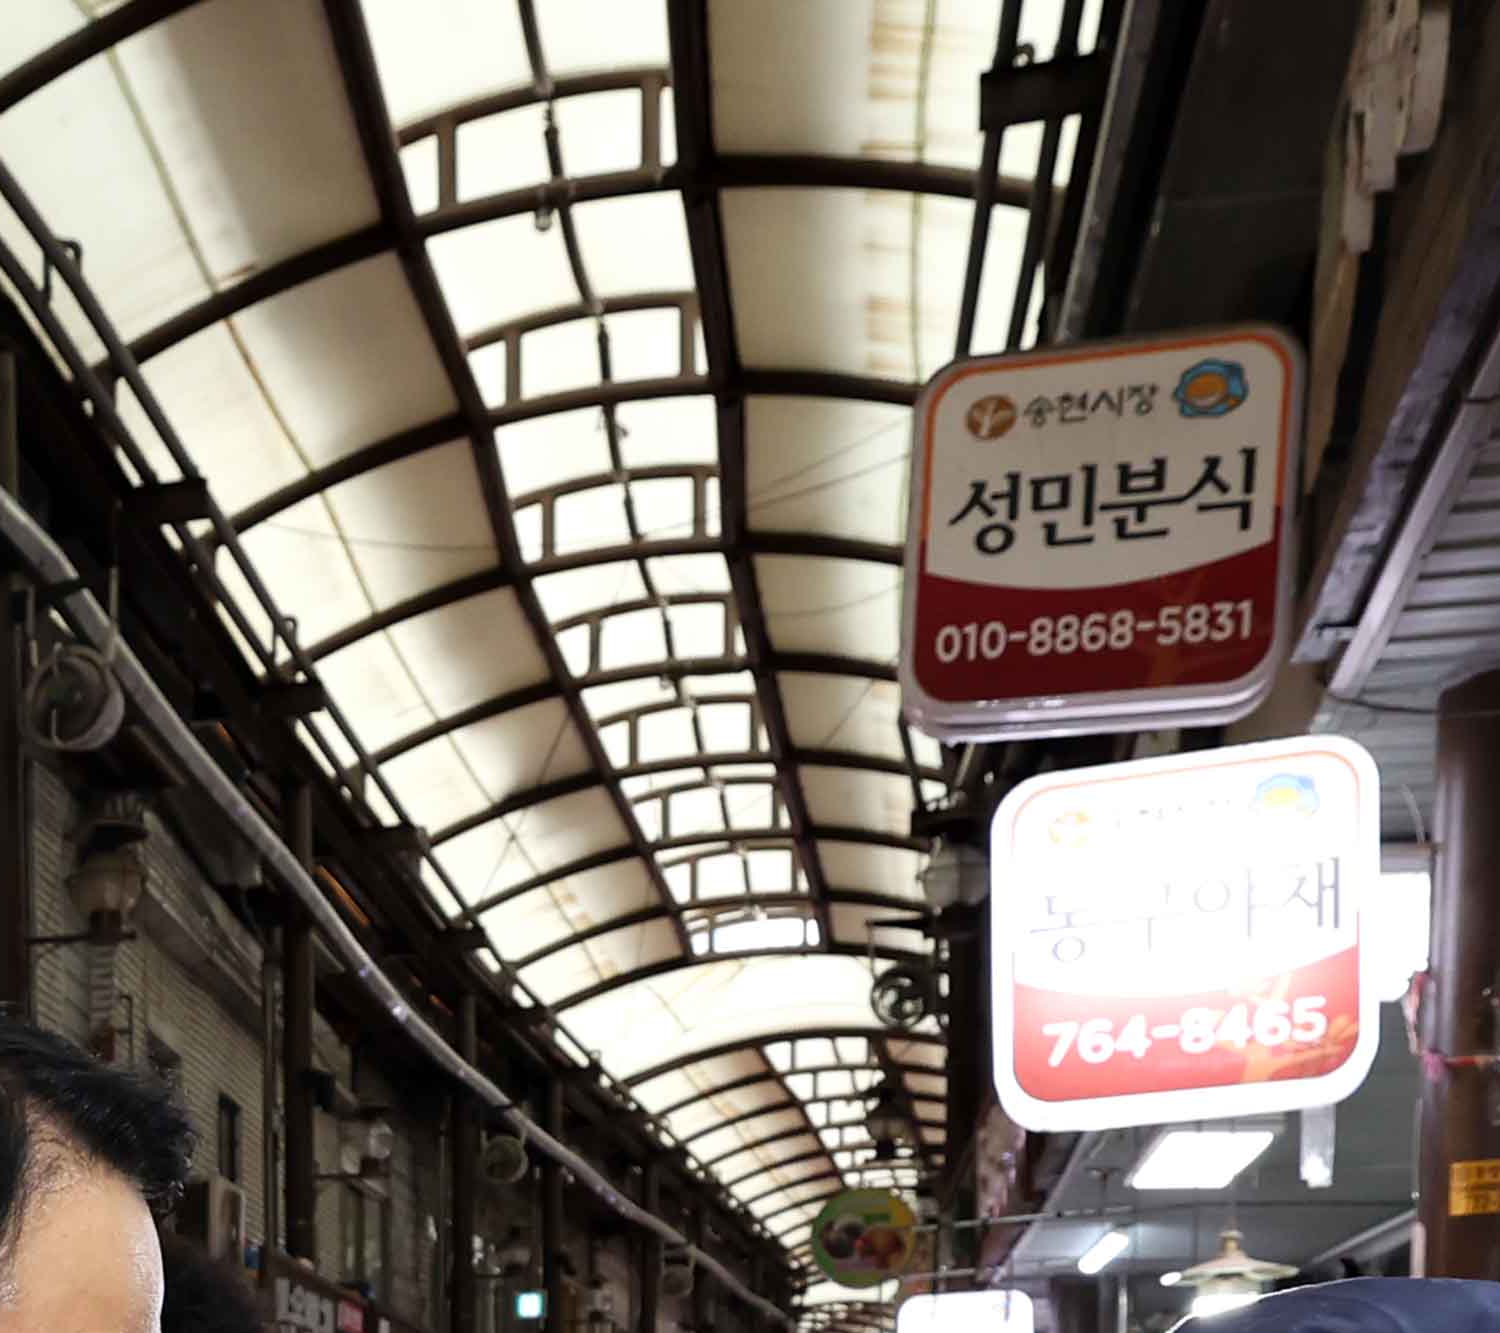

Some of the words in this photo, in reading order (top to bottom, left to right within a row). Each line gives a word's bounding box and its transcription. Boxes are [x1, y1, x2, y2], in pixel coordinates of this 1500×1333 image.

[1022, 381, 1161, 429] 송현시장
[948, 444, 1258, 557] 성민분식
[935, 600, 1254, 667] 010-8868-5831
[1041, 994, 1328, 1068] 764-8465
